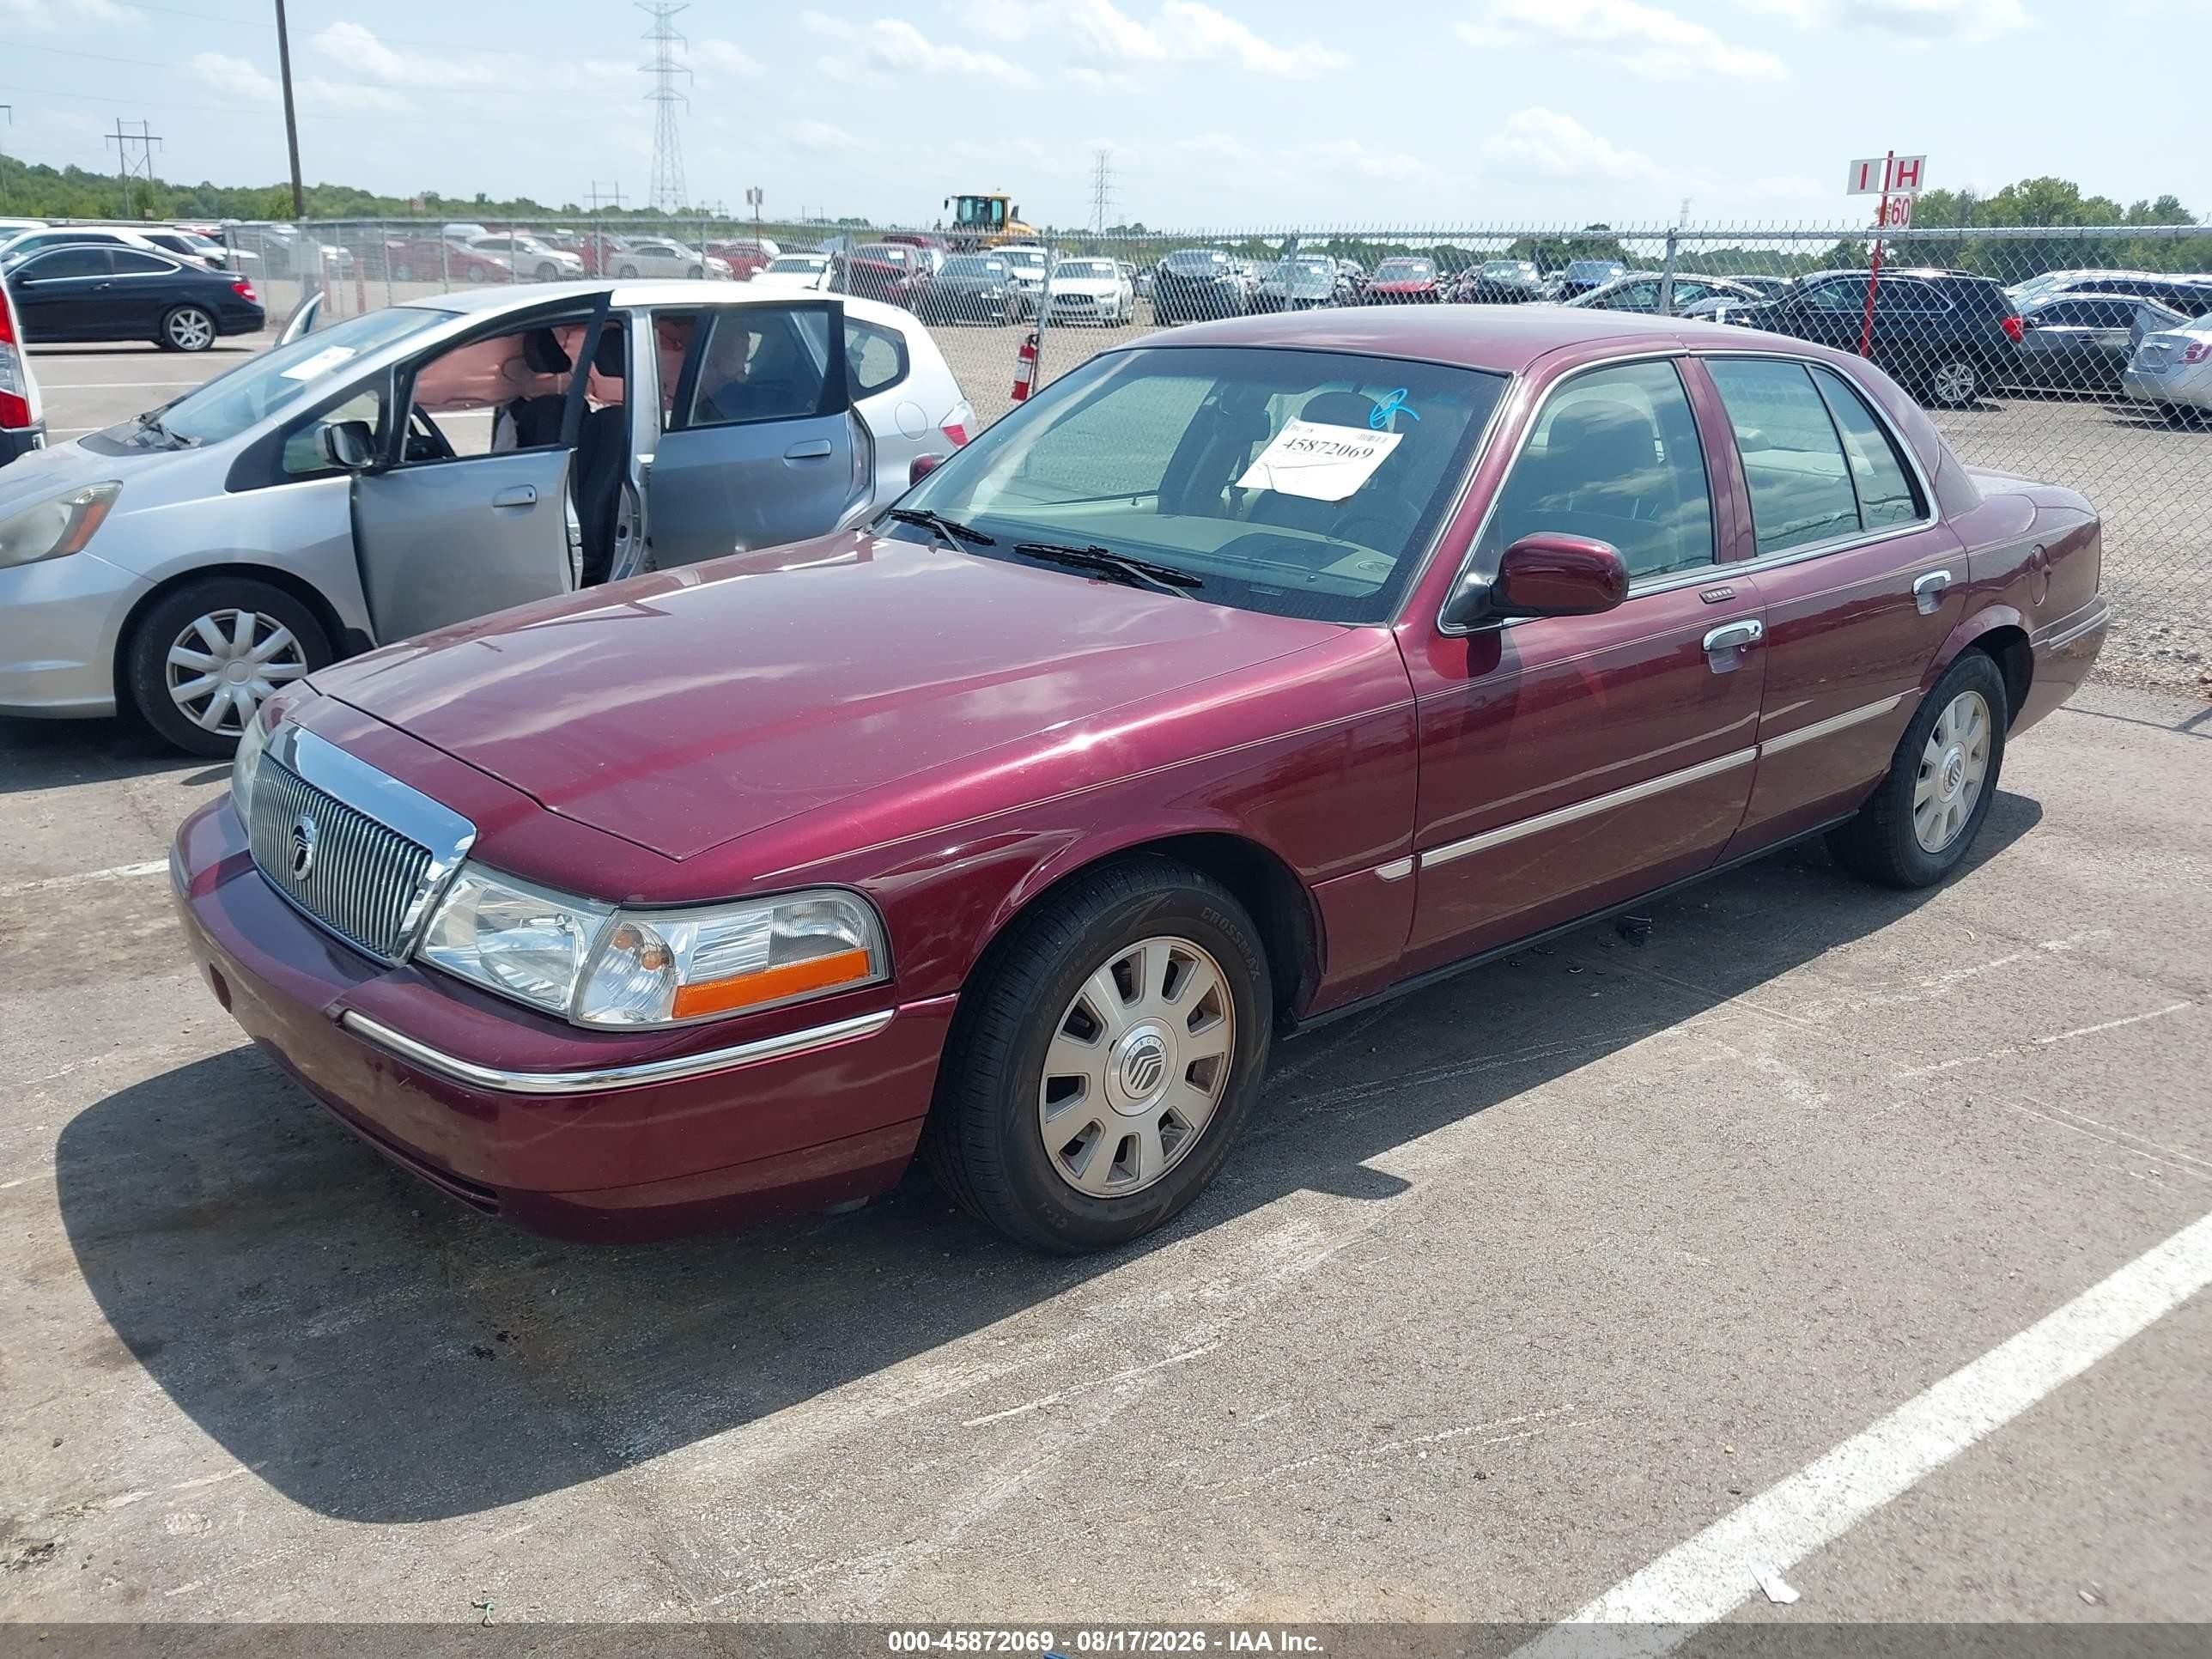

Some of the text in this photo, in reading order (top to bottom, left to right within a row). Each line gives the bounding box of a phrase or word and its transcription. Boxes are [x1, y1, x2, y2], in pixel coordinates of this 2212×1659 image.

[1860, 160, 1919, 190] I H
[1892, 198, 1910, 225] 60
[1283, 438, 1374, 459] 45872069
[1200, 906, 1261, 982] CROSSMAX
[1127, 1038, 1165, 1061] MERCURY
